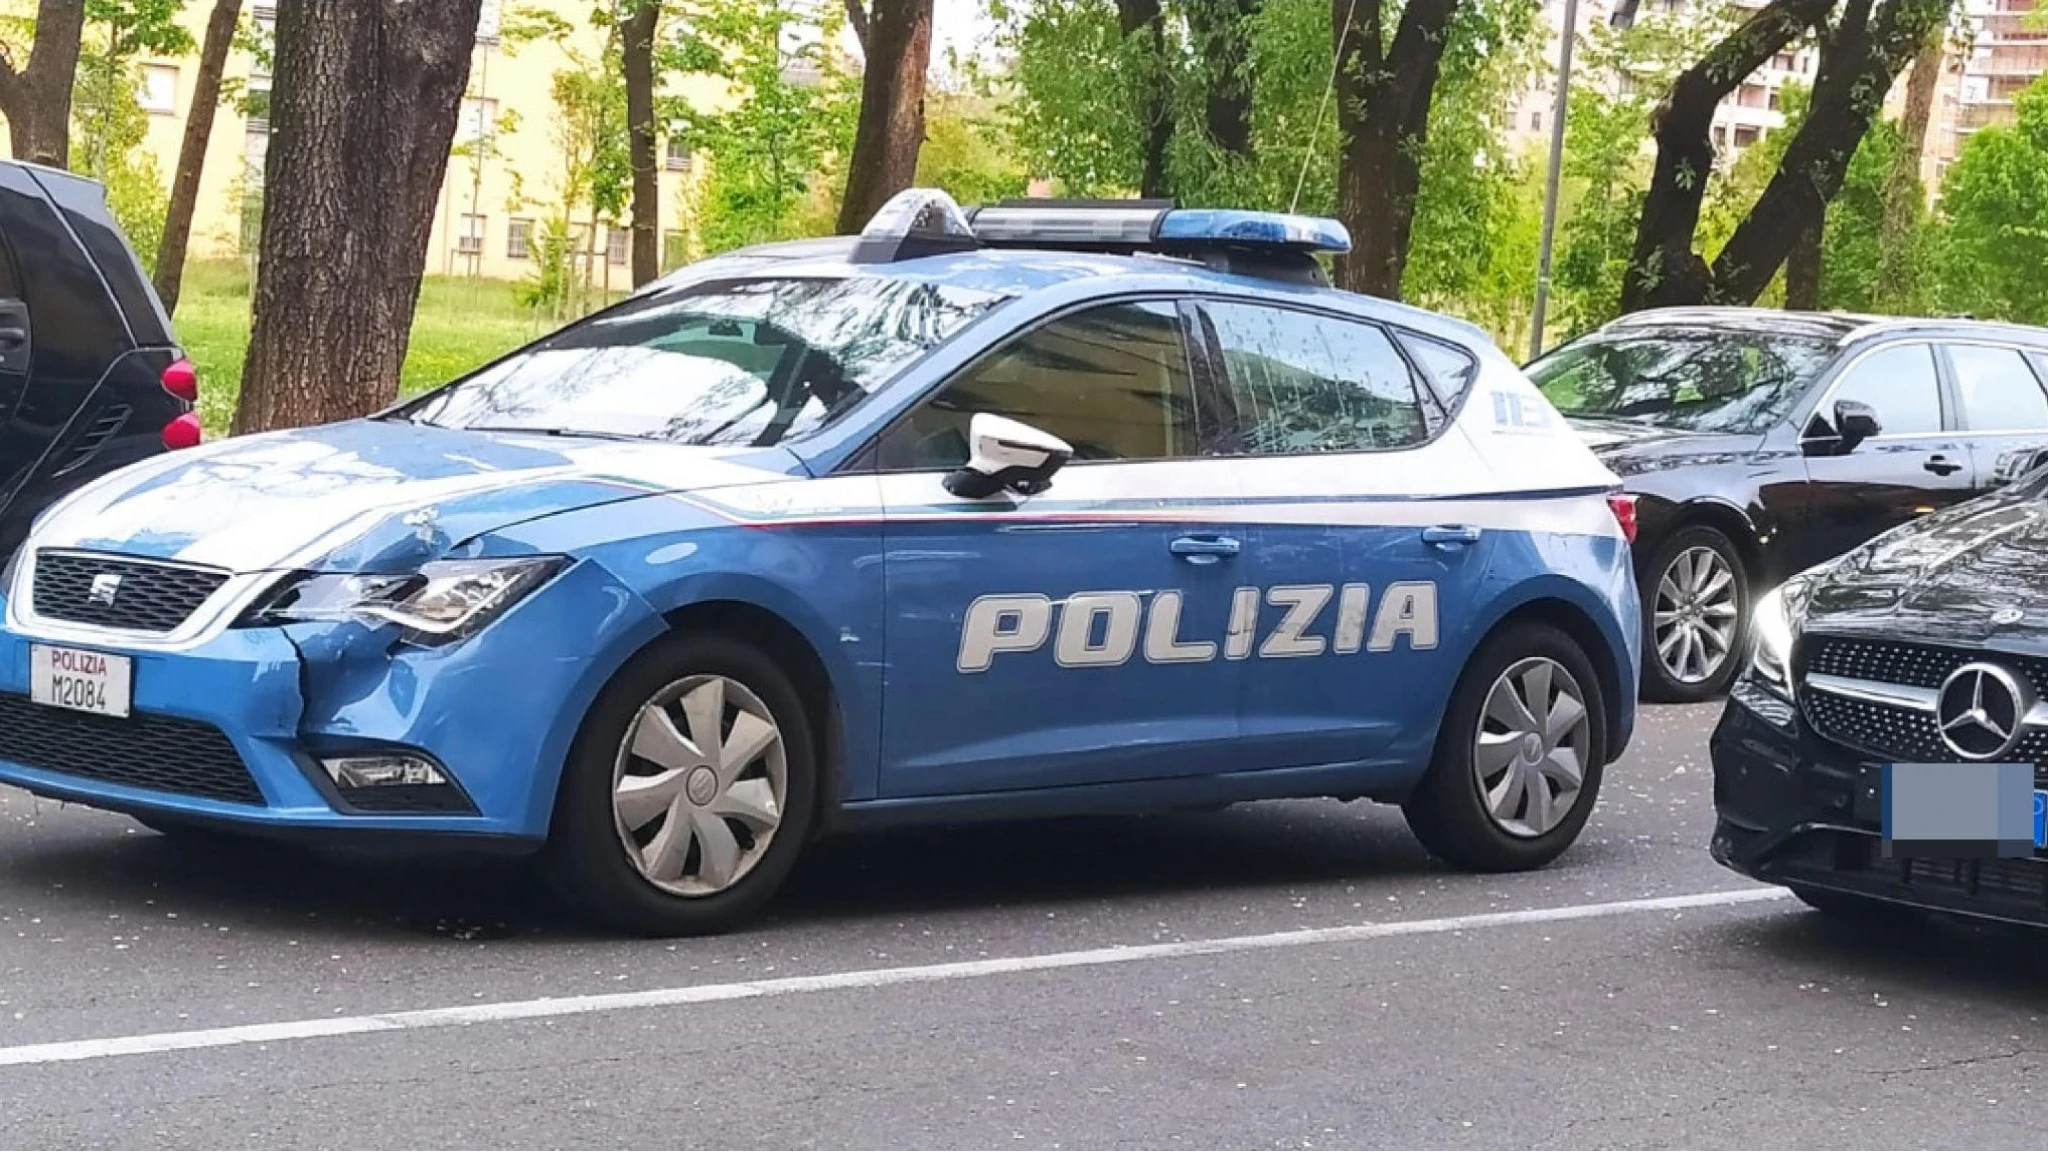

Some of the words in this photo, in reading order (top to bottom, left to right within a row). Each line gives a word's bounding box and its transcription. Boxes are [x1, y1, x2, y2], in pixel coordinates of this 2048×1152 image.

[957, 581, 1438, 673] POLIZIA
[52, 649, 107, 676] POLIZIA
[52, 675, 105, 709] M2084
